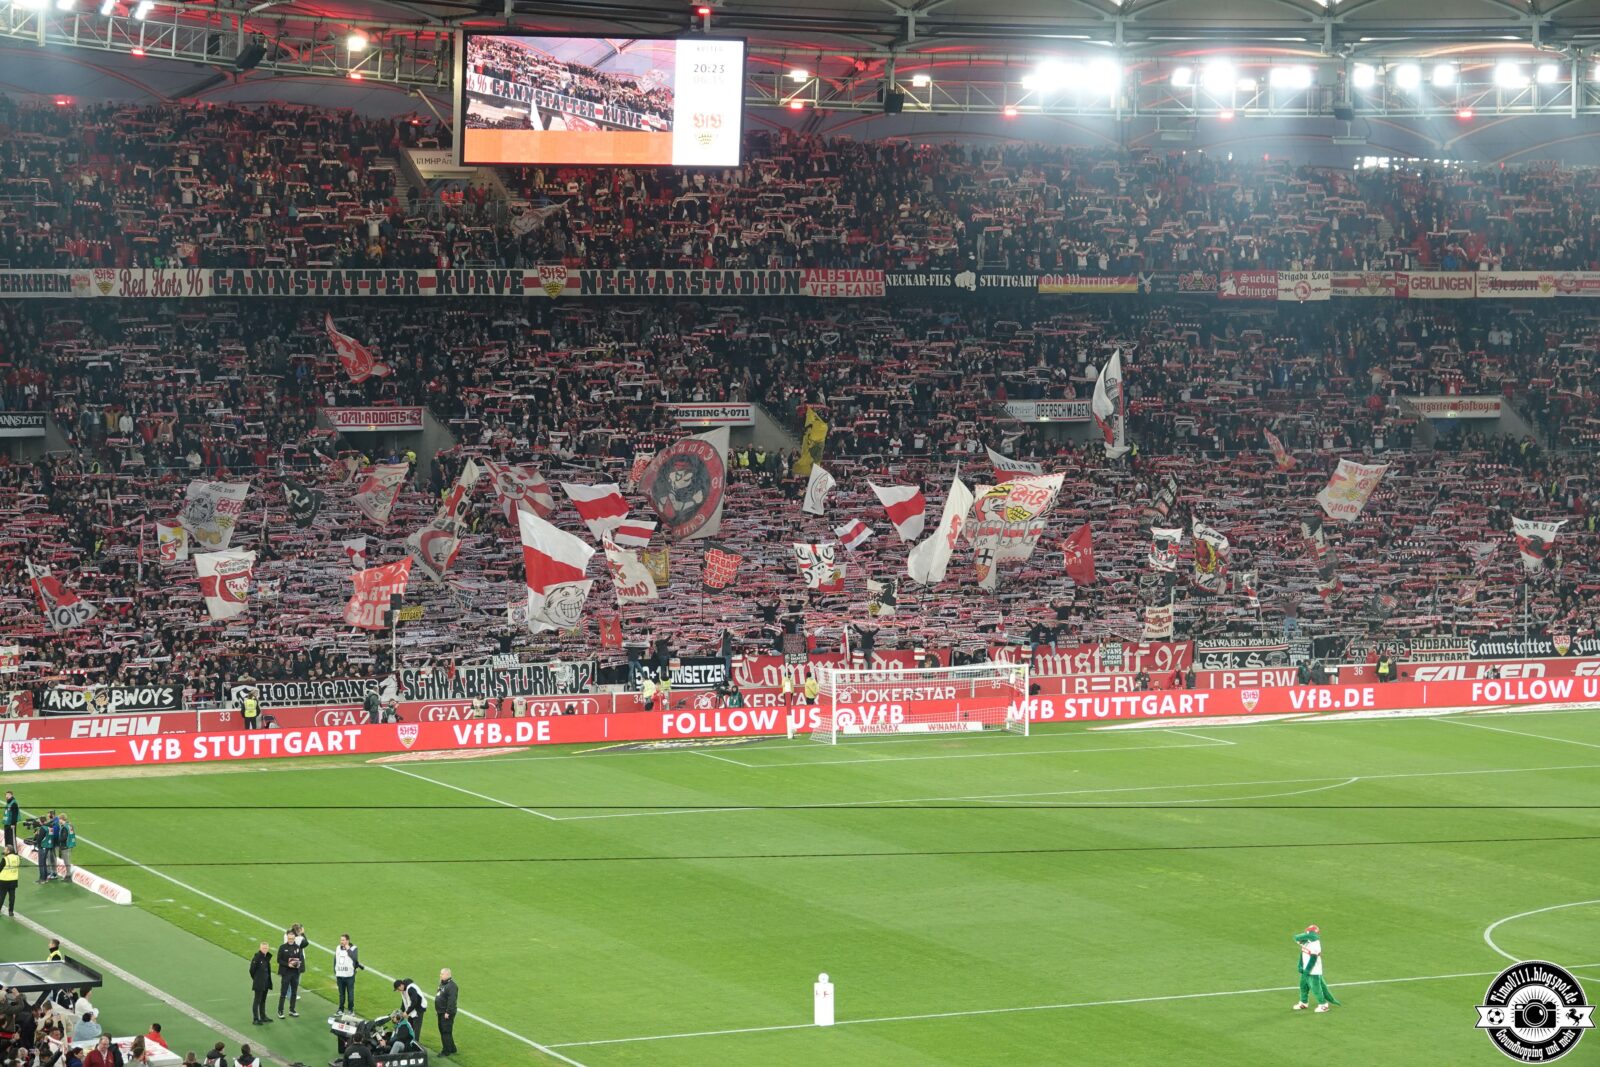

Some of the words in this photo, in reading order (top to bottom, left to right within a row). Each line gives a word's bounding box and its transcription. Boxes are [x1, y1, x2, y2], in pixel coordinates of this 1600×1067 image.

[693, 63, 725, 74] 20:23
[491, 78, 596, 118] CANNSTATTER
[602, 106, 643, 127] KURVE
[119, 269, 148, 297] Red
[151, 269, 183, 297] Hots
[187, 269, 204, 297] 96
[213, 269, 420, 296] CANNSTATTER
[436, 269, 524, 296] KURVE
[539, 267, 567, 282] VfB
[580, 270, 800, 296] NECKARSTADION
[808, 270, 885, 282] ALBSTADT
[885, 273, 952, 288] NECKAR-FILS
[979, 273, 1039, 288] STUTTGART
[811, 283, 884, 296] VFB-FANS
[1410, 276, 1473, 292] GERLINGEN
[364, 411, 407, 424] ADDICTS
[730, 409, 750, 417] 0711
[1036, 403, 1091, 417] OBERSCHWABEN
[1197, 638, 1245, 649] SCHWABEN
[1248, 636, 1289, 647] KOMPANIE
[1470, 639, 1552, 656] Cannstatter
[1153, 644, 1189, 672] 97
[1412, 652, 1469, 662] STUTTGART
[1353, 666, 1364, 676] 36
[257, 680, 379, 702] HOOLIGANS
[991, 680, 1002, 690] 35
[1472, 679, 1574, 702] FOLLOW
[112, 687, 174, 706] BWOYS
[633, 694, 644, 704] 34
[857, 686, 957, 704] JOKERSTAR
[1288, 687, 1375, 709] VfB.DE
[1010, 698, 1055, 721] VfB
[1064, 693, 1209, 719] STUTTGART
[219, 711, 231, 722] 33
[661, 708, 779, 735] FOLLOW
[790, 708, 821, 730] US
[835, 704, 905, 729] @VfB
[70, 716, 161, 739] EHEIM
[453, 720, 551, 746] VfB.DE
[128, 738, 182, 762] VfB
[193, 729, 362, 760] STUTTGART
